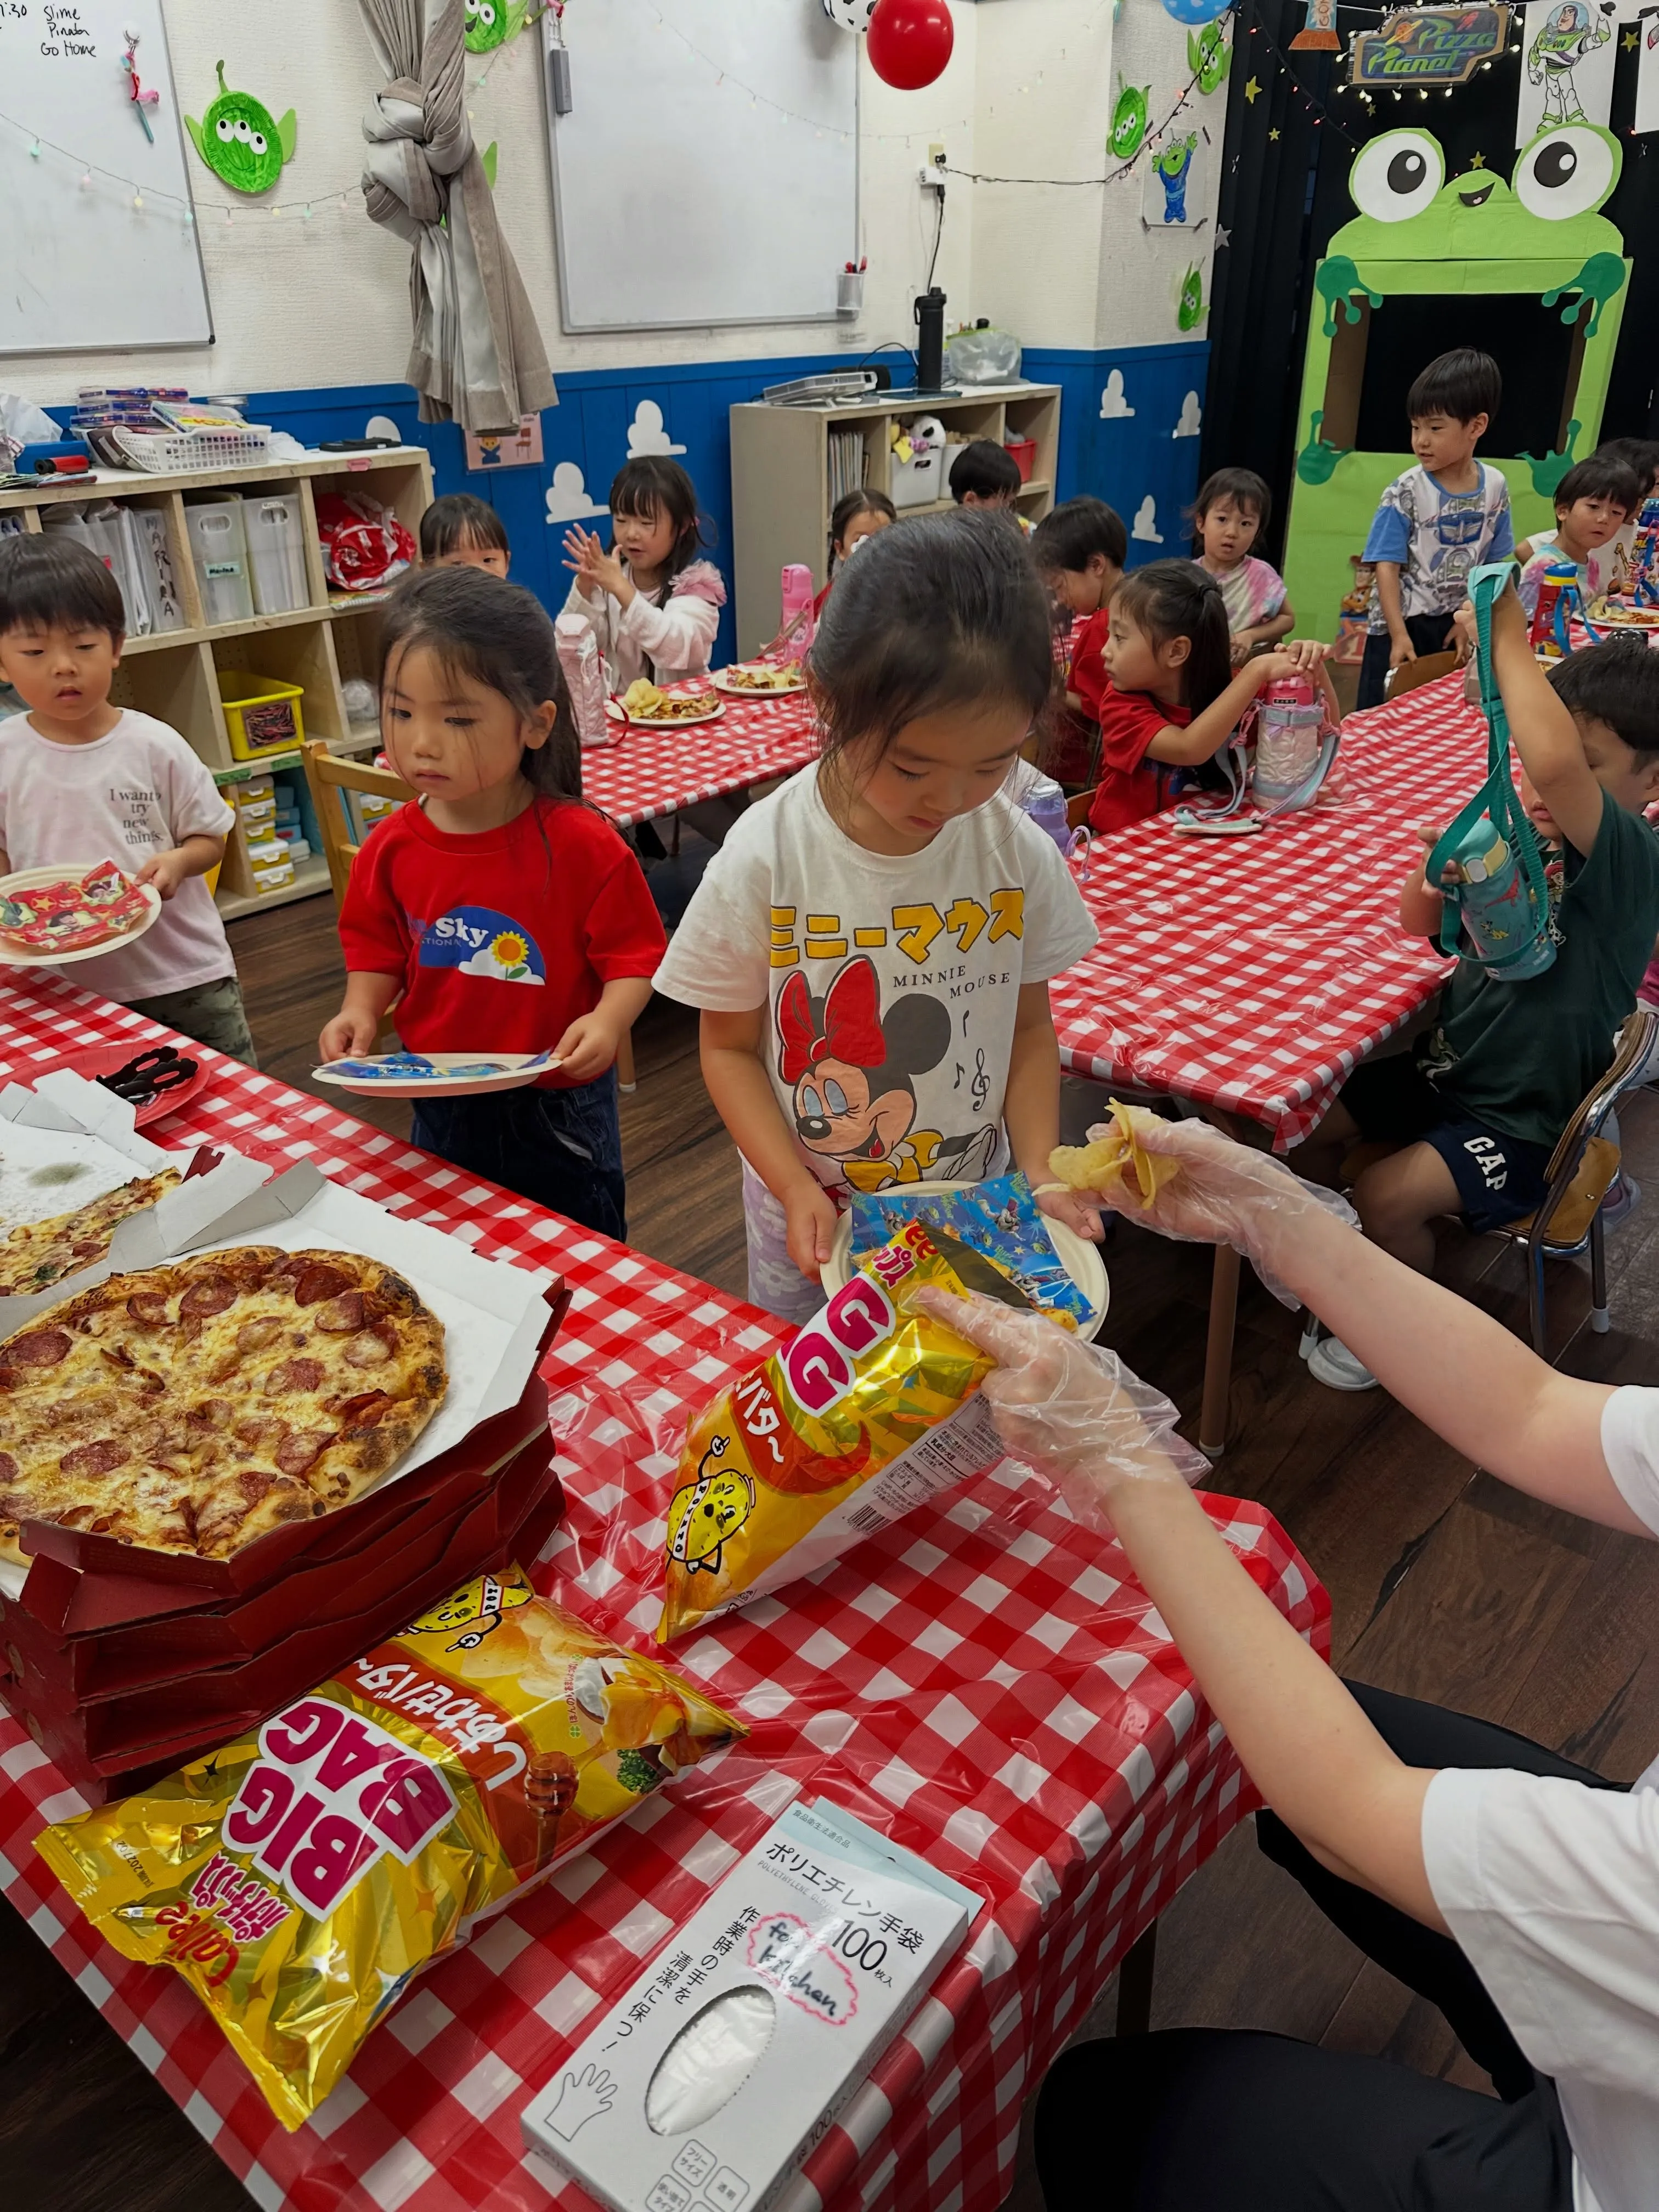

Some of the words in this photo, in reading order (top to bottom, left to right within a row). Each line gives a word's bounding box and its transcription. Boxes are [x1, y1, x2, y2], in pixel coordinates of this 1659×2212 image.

[43, 4, 80, 21] Slime
[41, 42, 59, 55] Go
[64, 40, 97, 57] Home
[1419, 18, 1496, 50] Pizza
[1365, 43, 1460, 74] Planet
[110, 789, 115, 801] I
[131, 804, 151, 816] try
[123, 818, 149, 828] new
[436, 917, 489, 947] Sky
[770, 887, 1024, 968] ミニーマウス
[893, 965, 966, 988] MINNIE
[950, 972, 1010, 999] MOUSE
[1464, 1137, 1507, 1190] GAP
[675, 1485, 707, 1553] POTATO
[266, 1701, 453, 1854] BAG
[229, 1767, 379, 1910] BIG
[793, 1810, 850, 1848] 食品衛生法適合品
[757, 1860, 810, 1896] POLYETHYLENE
[190, 1852, 293, 1942] ポテトチップス
[766, 1843, 924, 1954] ポリエチレン手袋
[675, 1906, 760, 2005] 作業時の手を
[601, 1951, 693, 2052] 清潔に保つ！
[680, 2157, 703, 2178] サイズ
[687, 2147, 708, 2166] フリー
